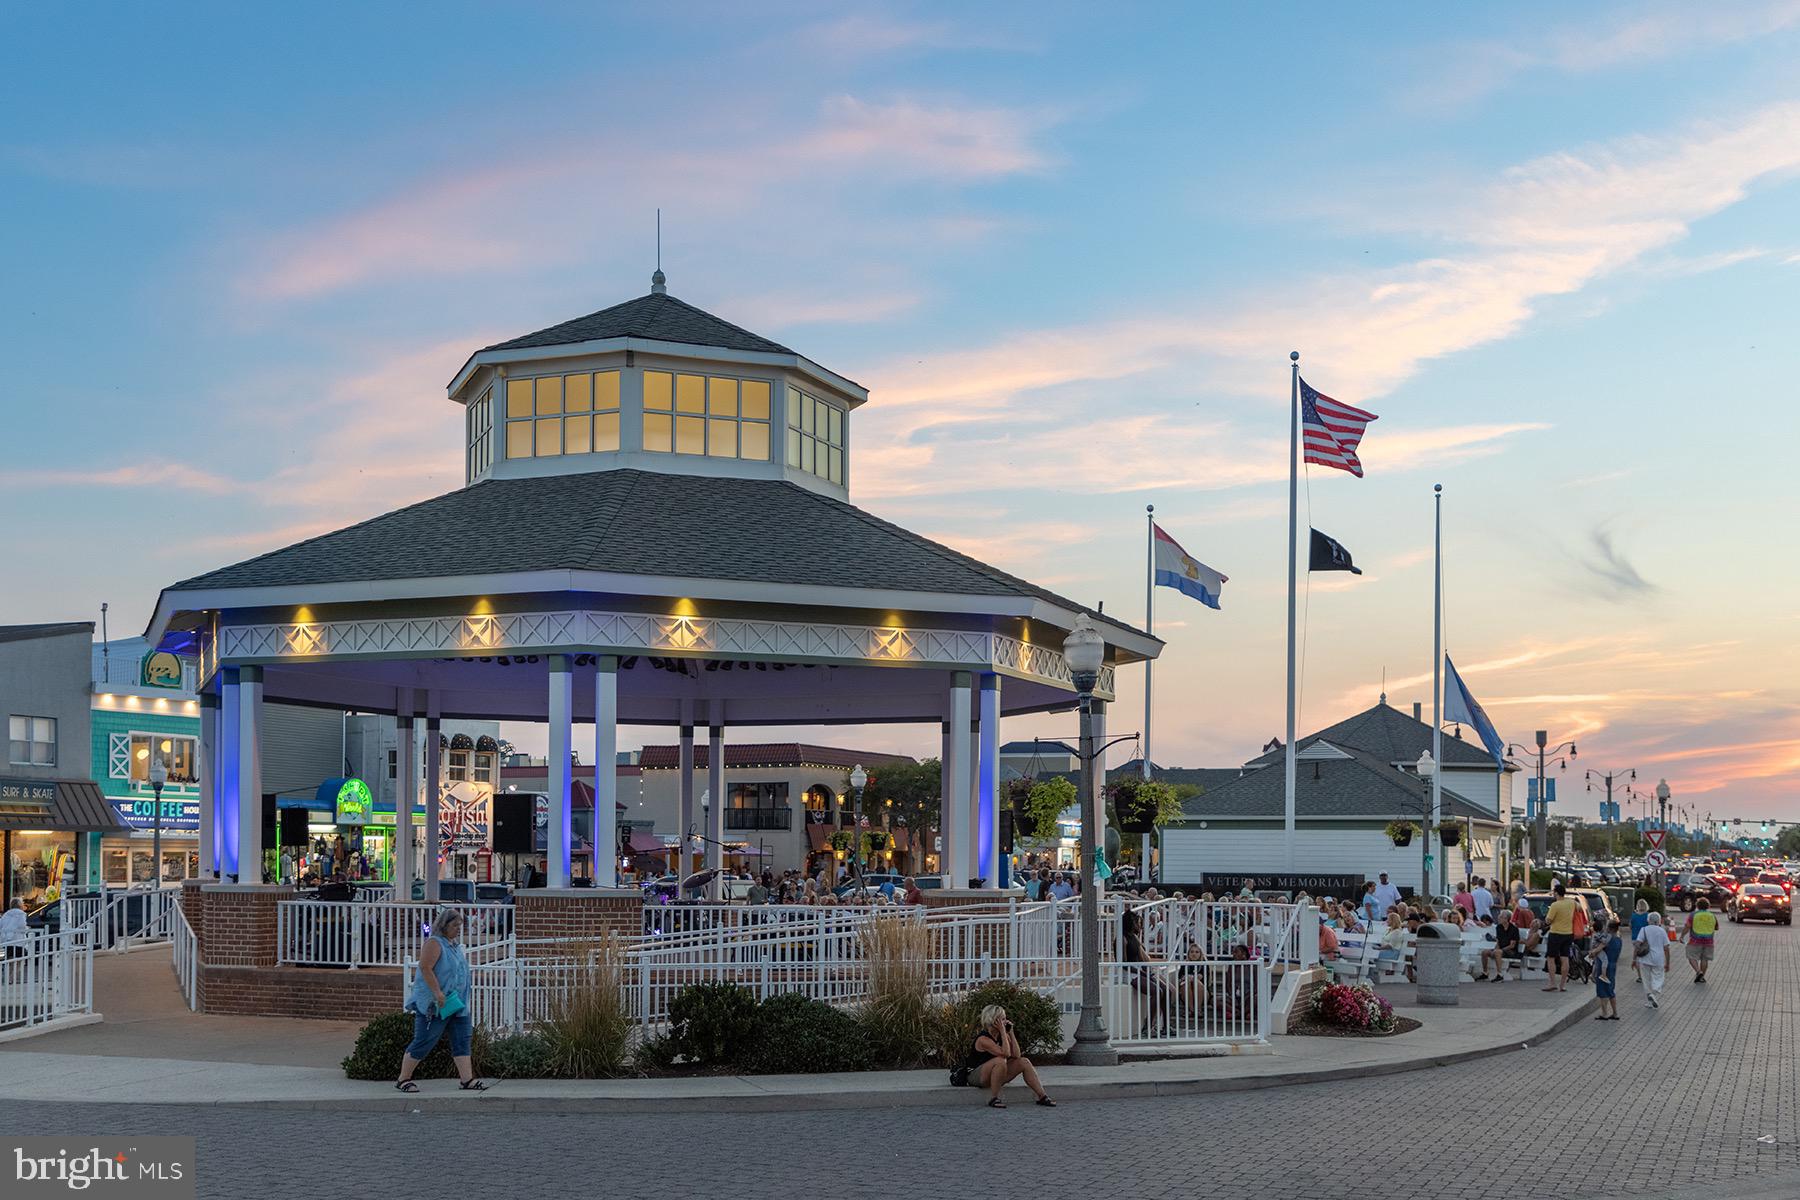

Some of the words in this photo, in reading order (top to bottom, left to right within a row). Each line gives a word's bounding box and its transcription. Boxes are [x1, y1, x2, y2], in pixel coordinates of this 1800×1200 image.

[2, 785, 20, 798] SURF
[22, 787, 29, 798] &
[32, 788, 54, 800] SKATE
[120, 803, 133, 812] THE
[183, 806, 199, 815] HOU
[1278, 877, 1349, 888] MEMORIAL
